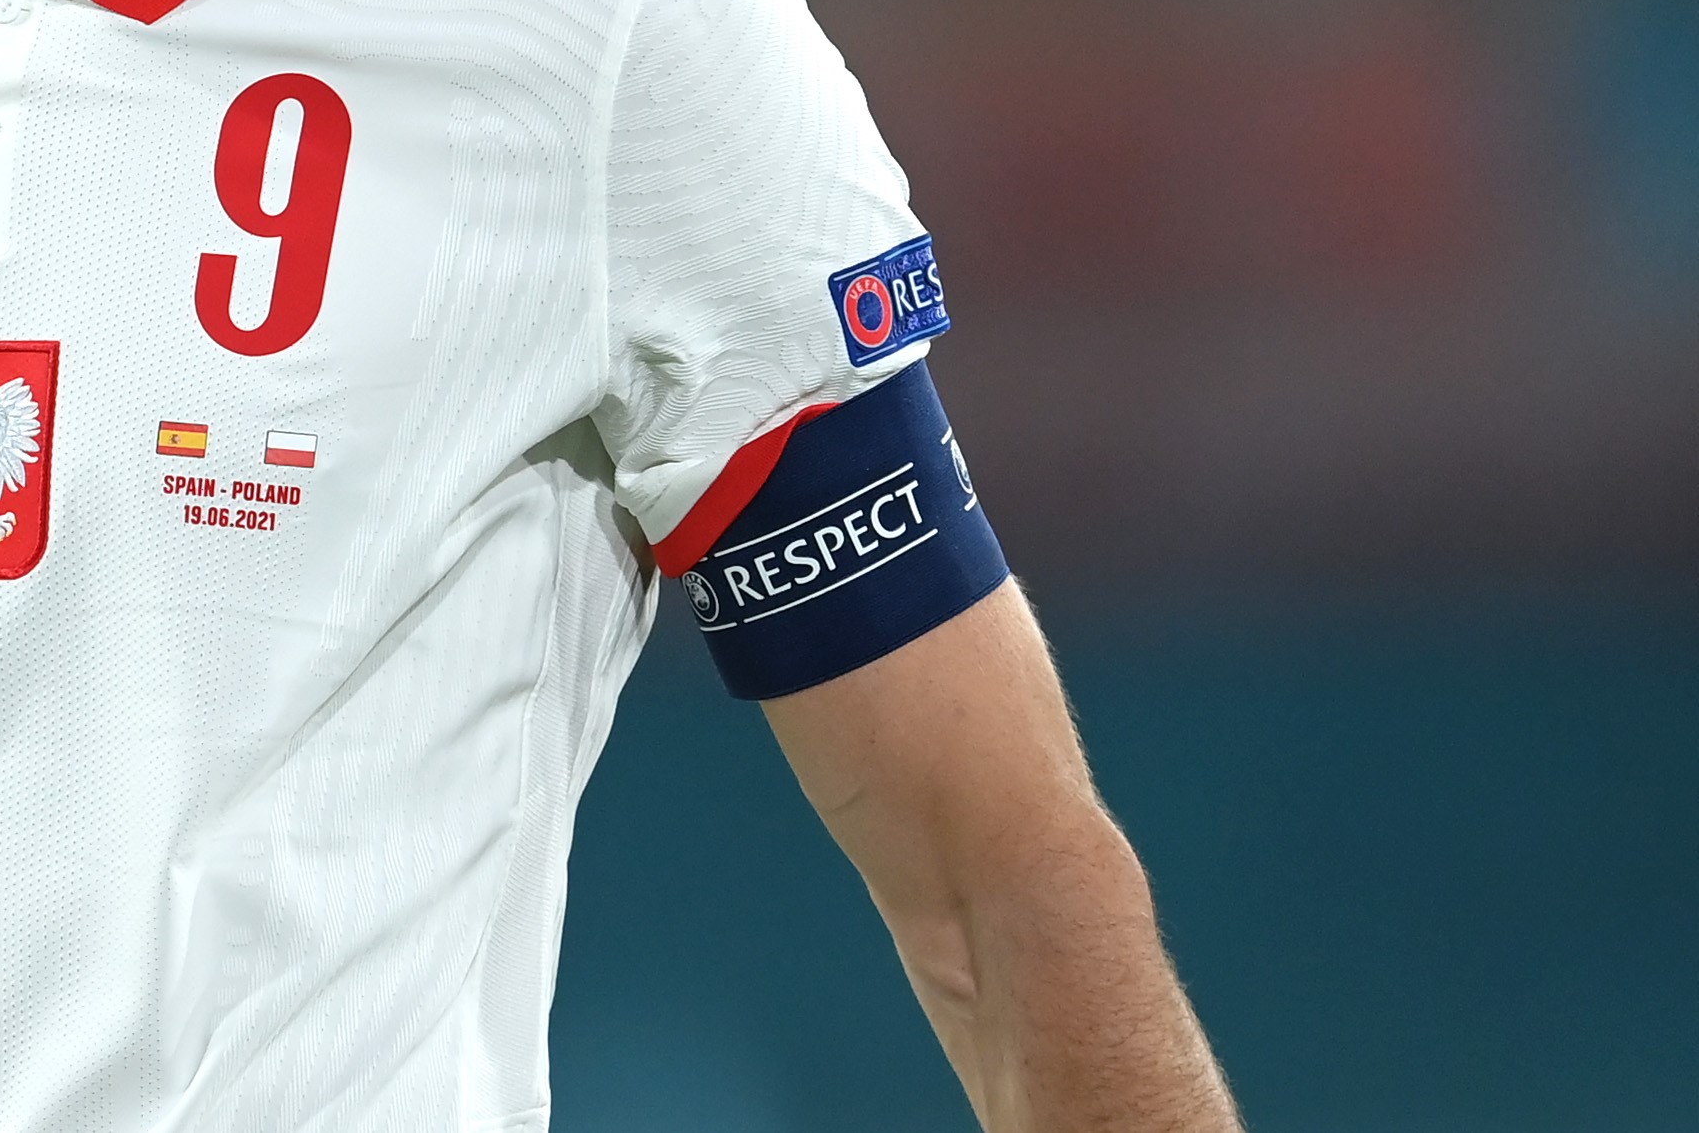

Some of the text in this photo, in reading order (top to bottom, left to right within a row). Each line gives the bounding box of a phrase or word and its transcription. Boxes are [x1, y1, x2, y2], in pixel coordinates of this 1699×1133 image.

[194, 72, 352, 357] 9
[849, 280, 879, 300] UEFA
[892, 262, 944, 317] RES
[163, 475, 216, 497] SPAIN
[231, 481, 301, 505] POLAND
[183, 504, 276, 531] 19.06.2021
[723, 480, 923, 607] RESPECT
